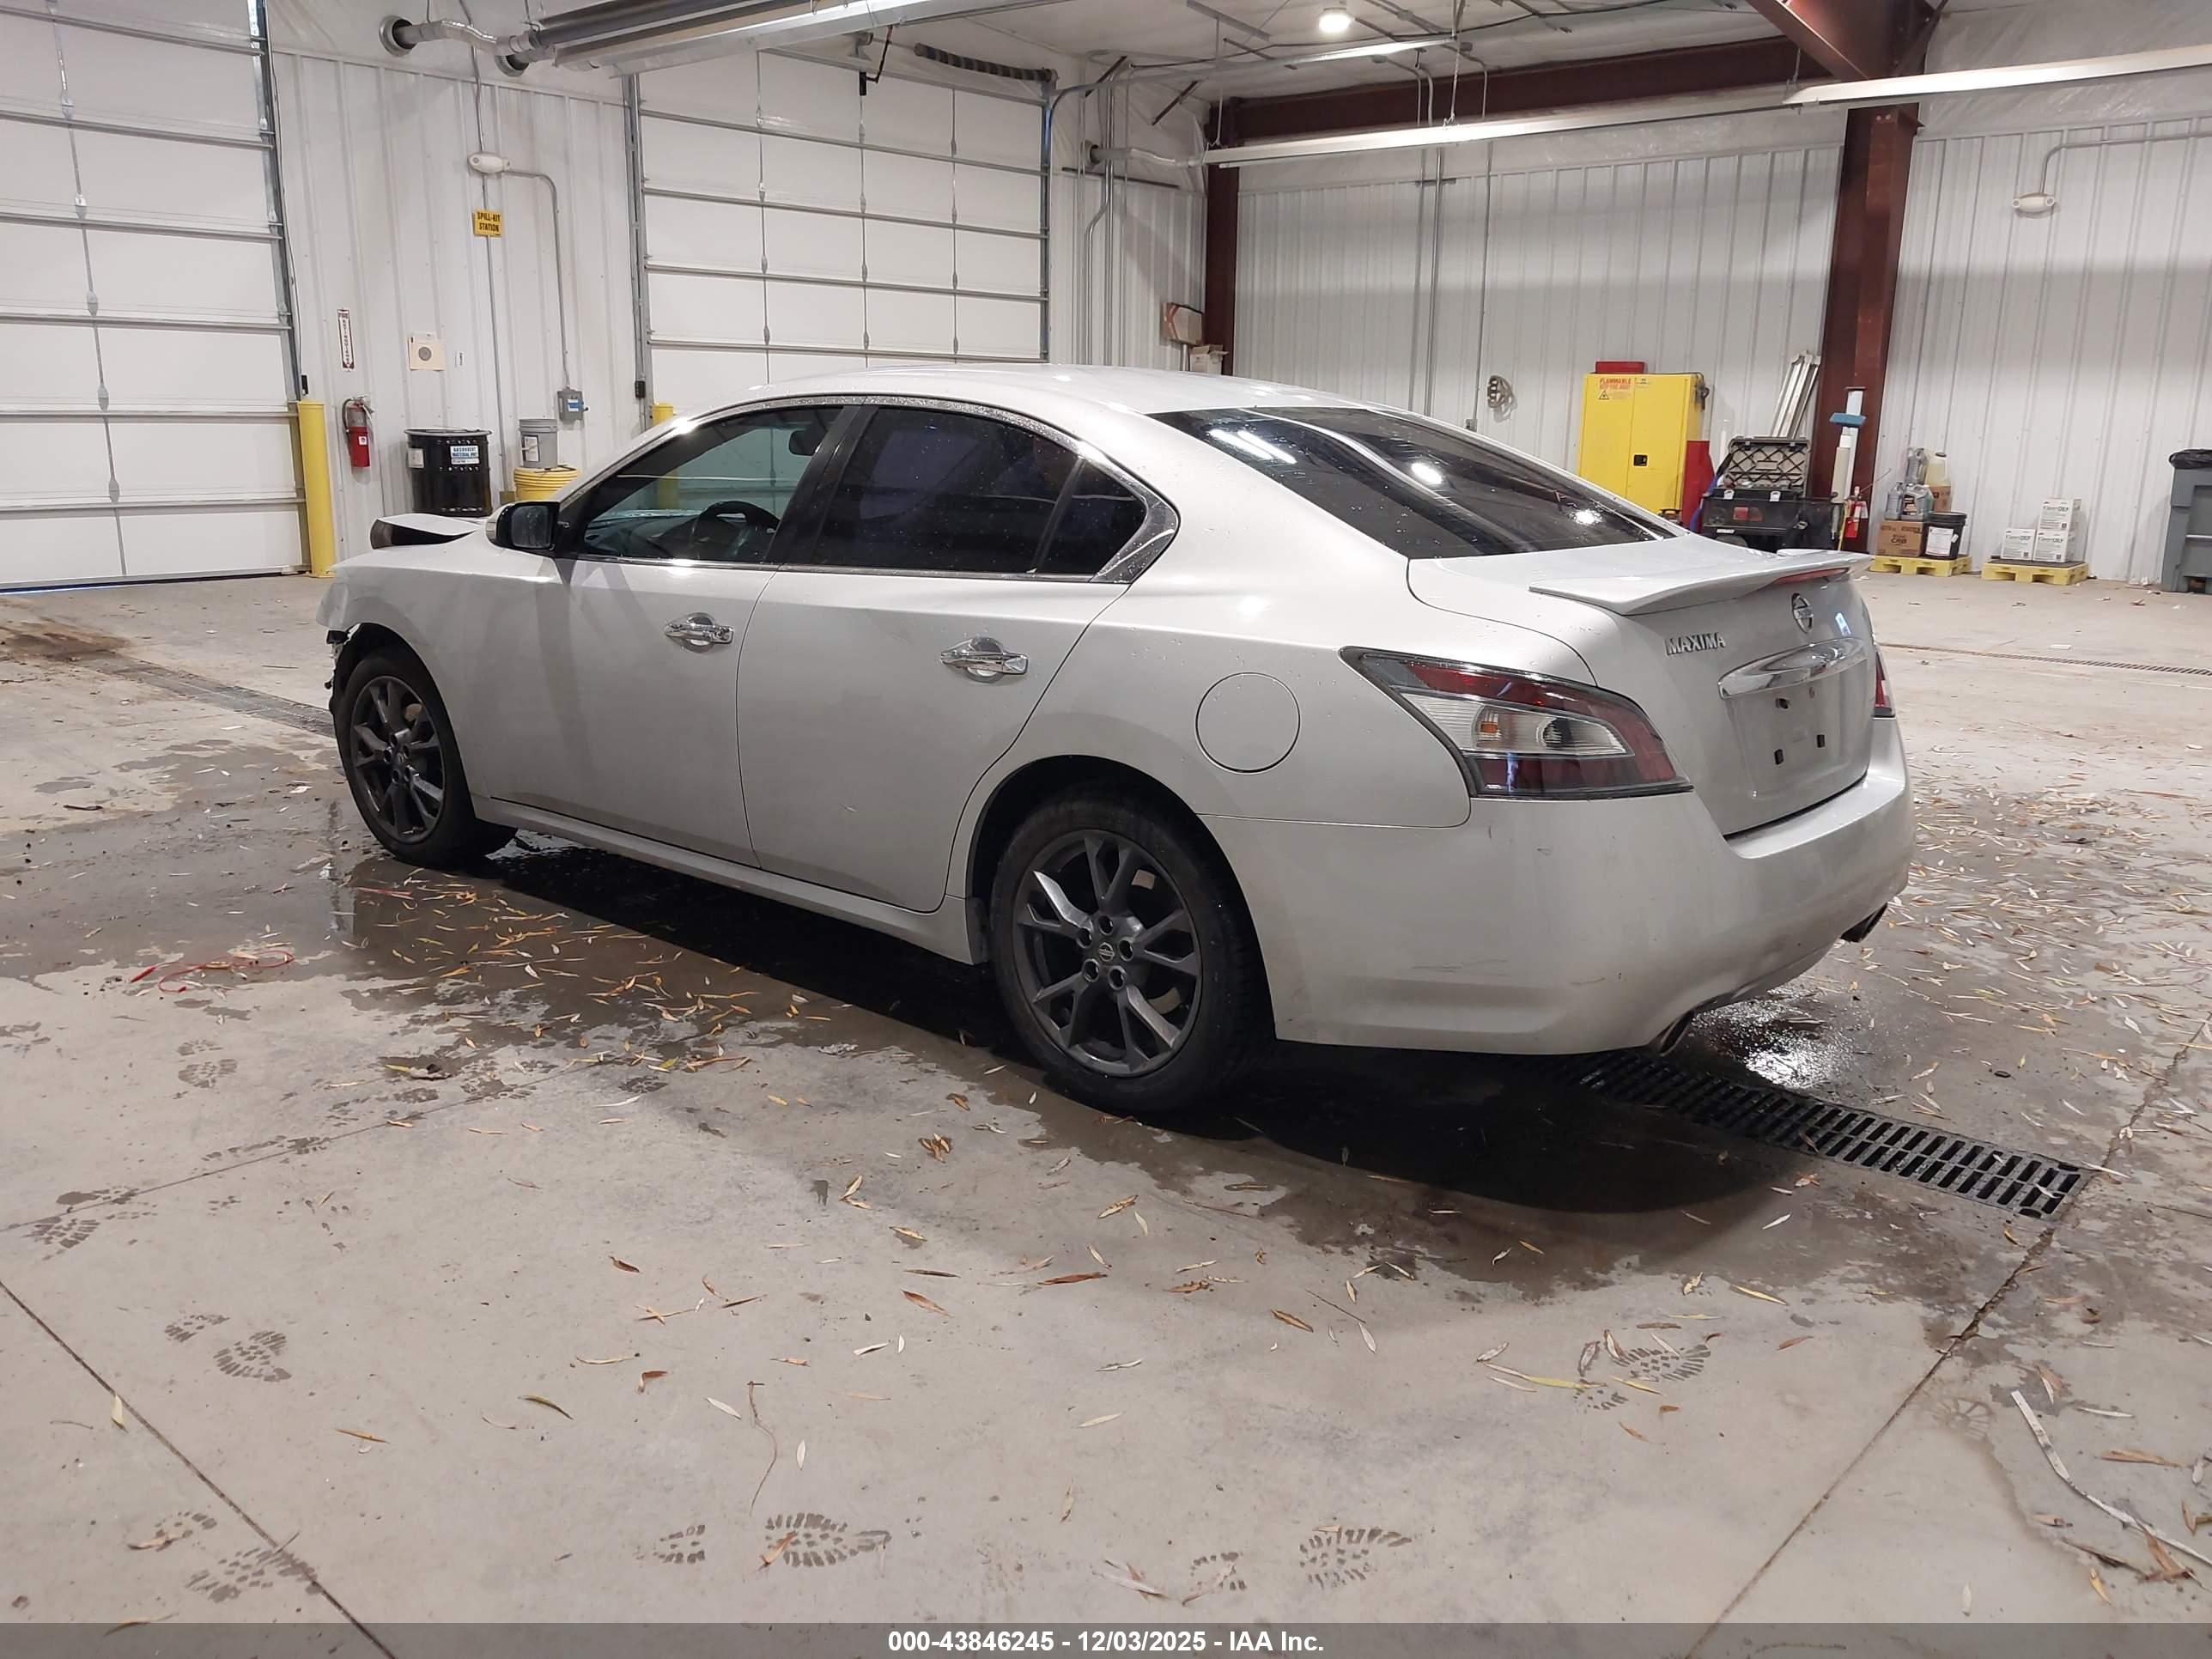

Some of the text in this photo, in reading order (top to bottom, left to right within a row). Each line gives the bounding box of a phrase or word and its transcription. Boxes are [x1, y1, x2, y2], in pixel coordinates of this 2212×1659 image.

[477, 211, 501, 222] SPILL-KIT
[479, 222, 500, 232] STATION
[1664, 632, 1726, 656] MAXIMA
